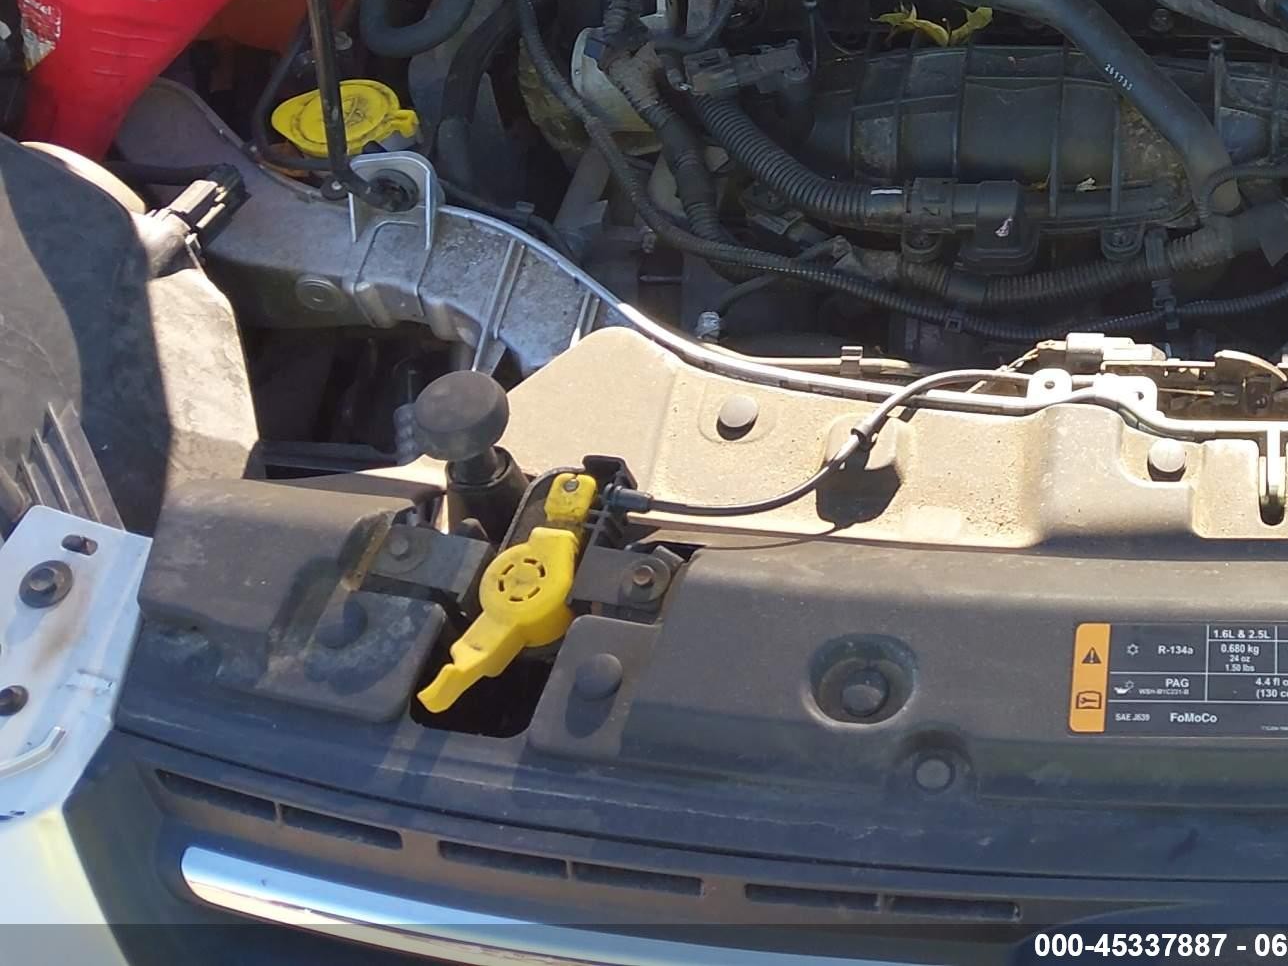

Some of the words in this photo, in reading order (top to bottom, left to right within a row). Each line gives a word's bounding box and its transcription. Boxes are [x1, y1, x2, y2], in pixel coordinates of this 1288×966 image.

[1213, 629, 1235, 639] 1.6L
[1237, 629, 1245, 639] &
[1248, 629, 1271, 639] 2.5L
[1157, 645, 1194, 655] R-134a
[1220, 643, 1246, 653] 0.680
[1247, 643, 1260, 655] kg
[1242, 664, 1255, 672] lbs
[1165, 678, 1189, 688] PAG
[1255, 677, 1271, 687] 4.4
[1273, 677, 1280, 687] fl
[1256, 689, 1278, 700] (130
[1115, 713, 1130, 721] SAE
[1169, 712, 1218, 723] FoMoCo
